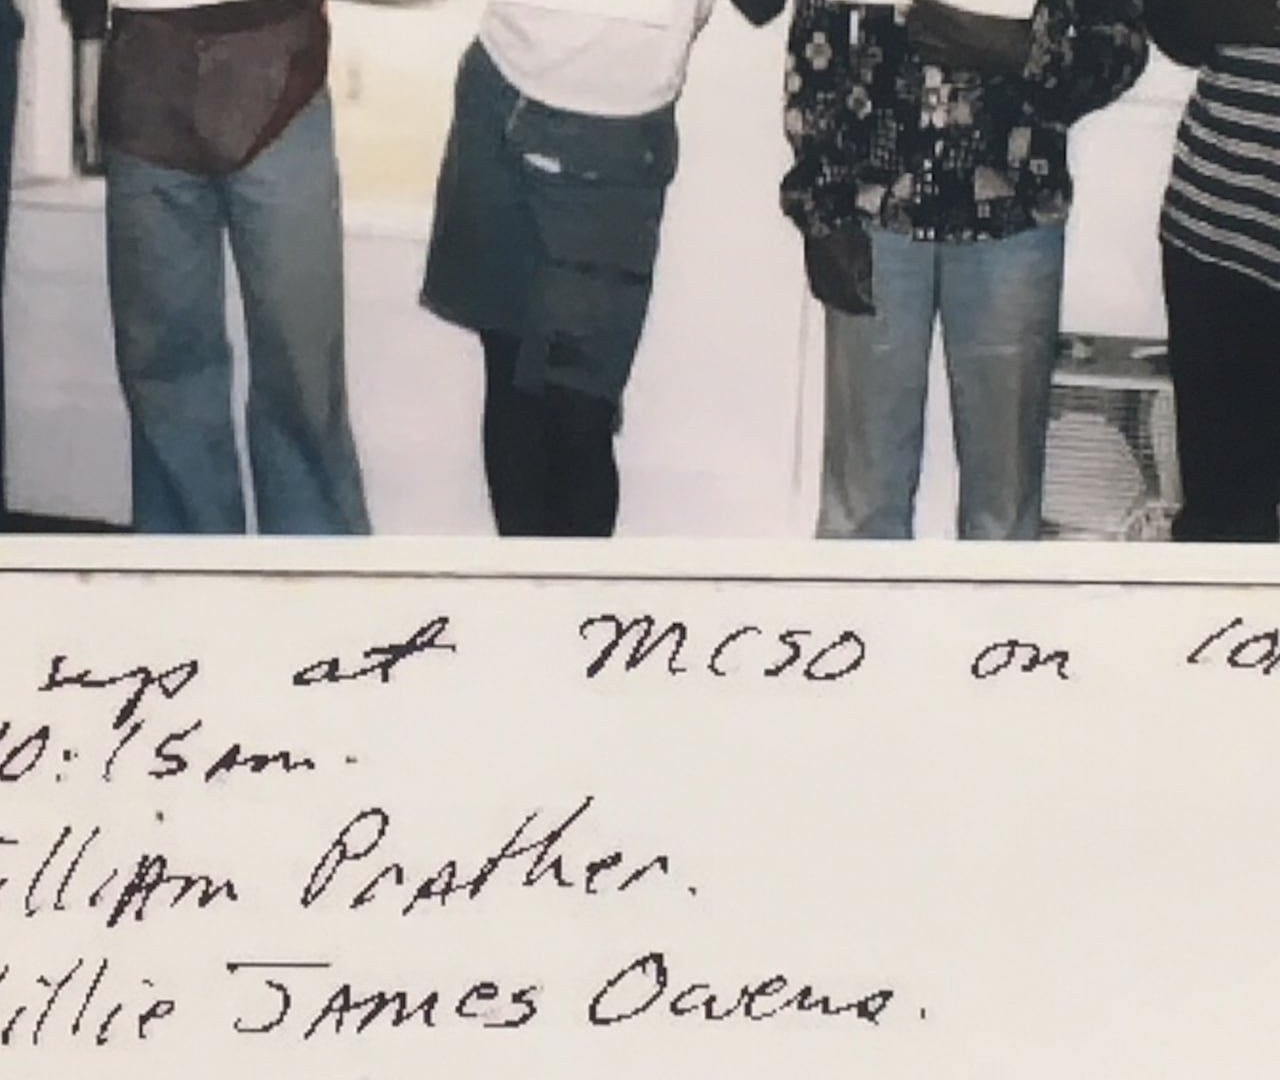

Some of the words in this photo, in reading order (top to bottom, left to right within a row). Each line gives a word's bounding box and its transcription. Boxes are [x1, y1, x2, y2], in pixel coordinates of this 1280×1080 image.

[292, 615, 457, 687] at
[578, 613, 866, 682] MCSO
[970, 638, 1070, 681] on
